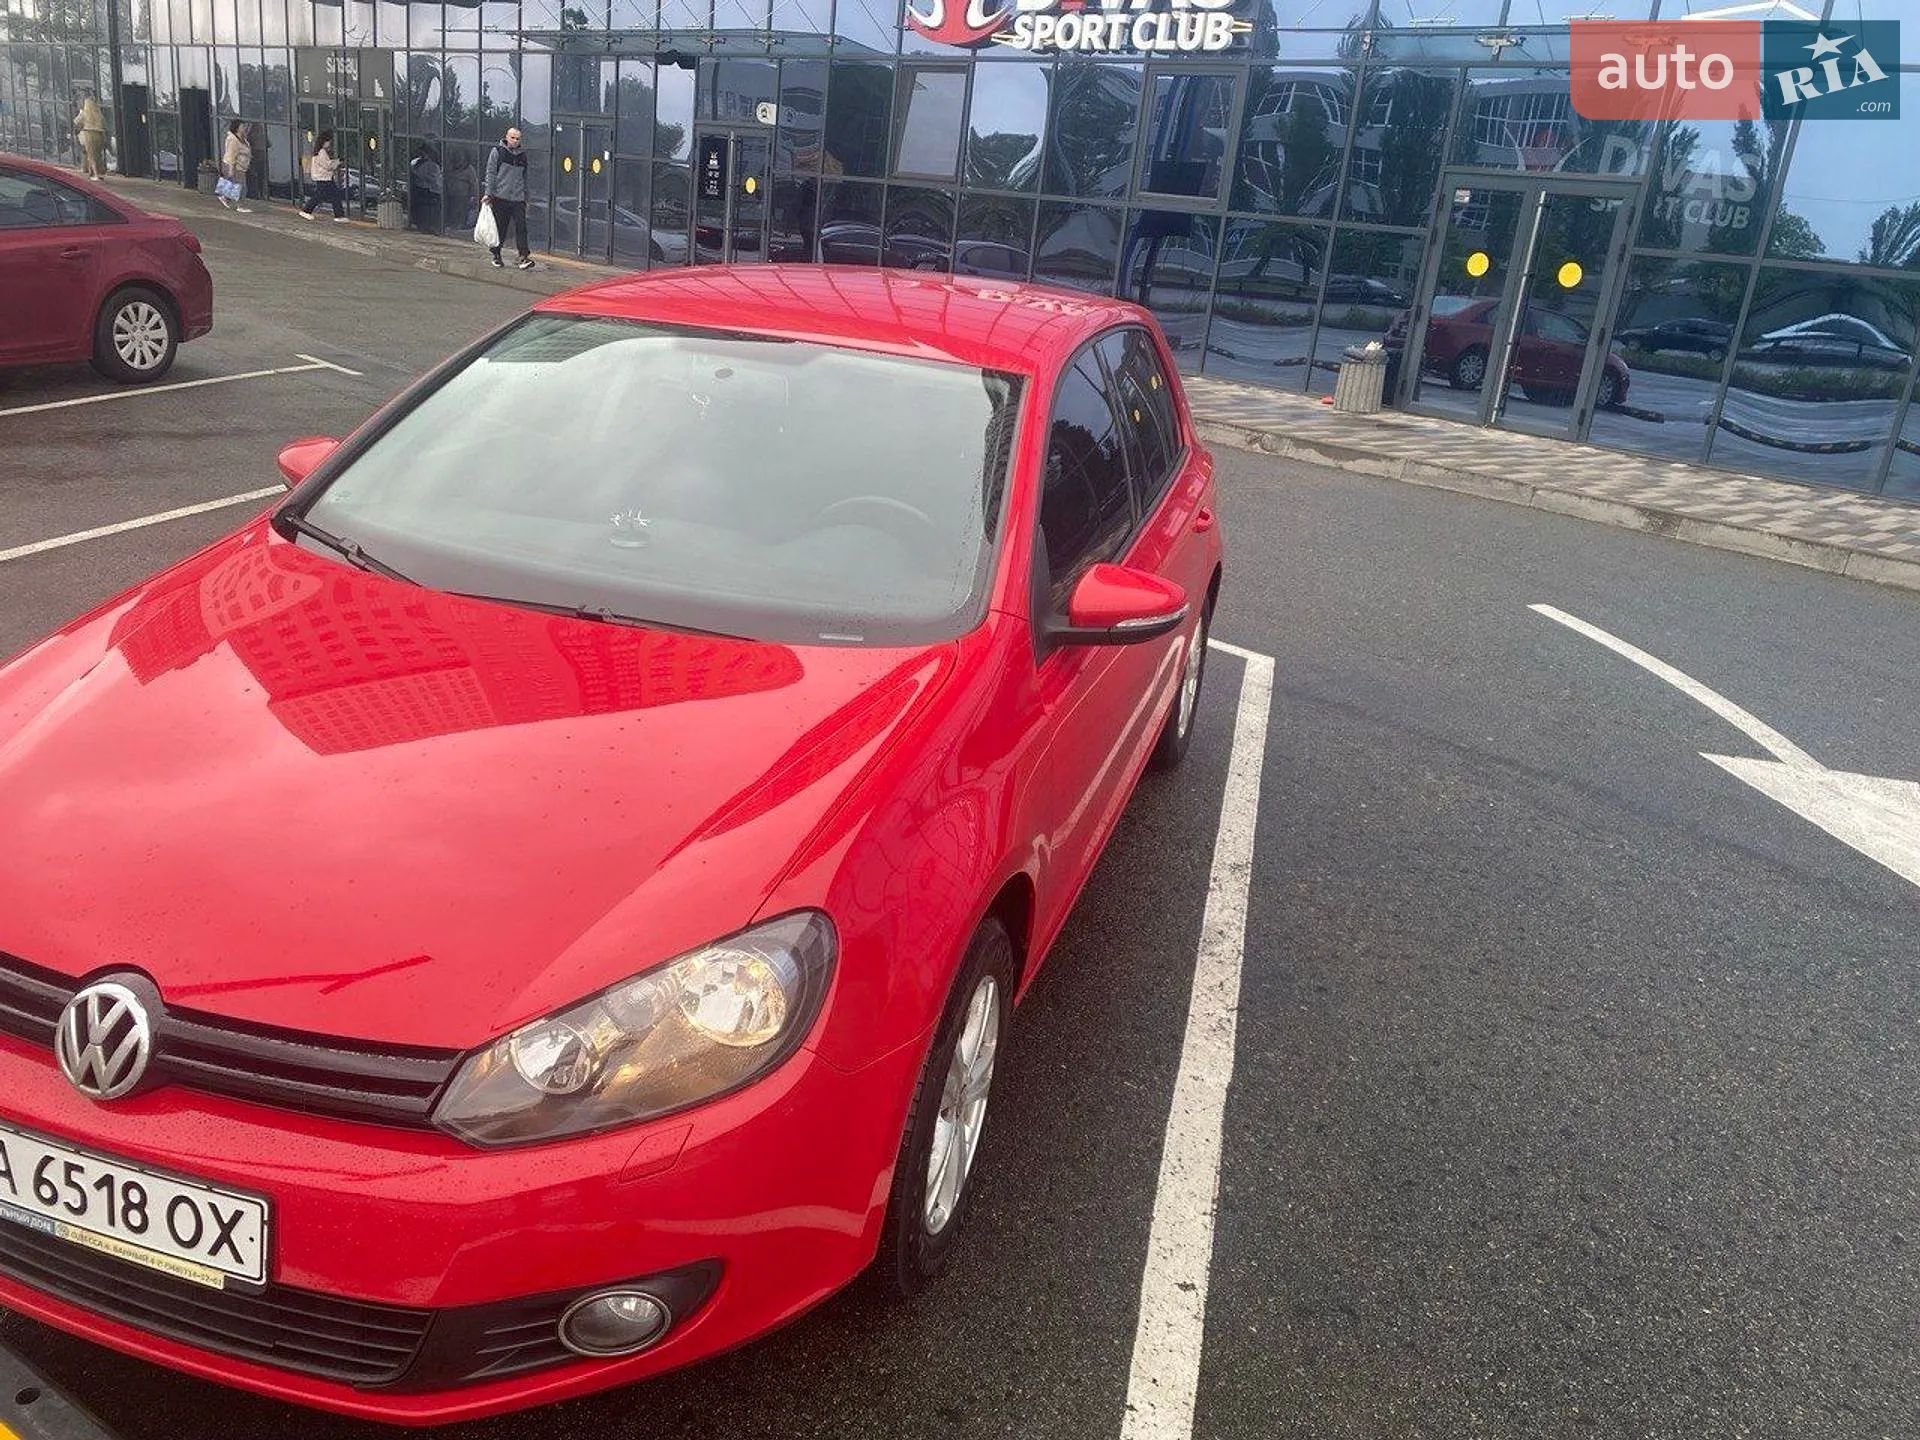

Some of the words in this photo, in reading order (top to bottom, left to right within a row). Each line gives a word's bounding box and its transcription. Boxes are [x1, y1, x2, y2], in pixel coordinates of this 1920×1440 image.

[1014, 12, 1129, 50] SPORT
[1132, 12, 1234, 51] CLUB
[1684, 199, 1751, 229] CLUB
[33, 1154, 149, 1235] 6518
[166, 1195, 244, 1265] OX
